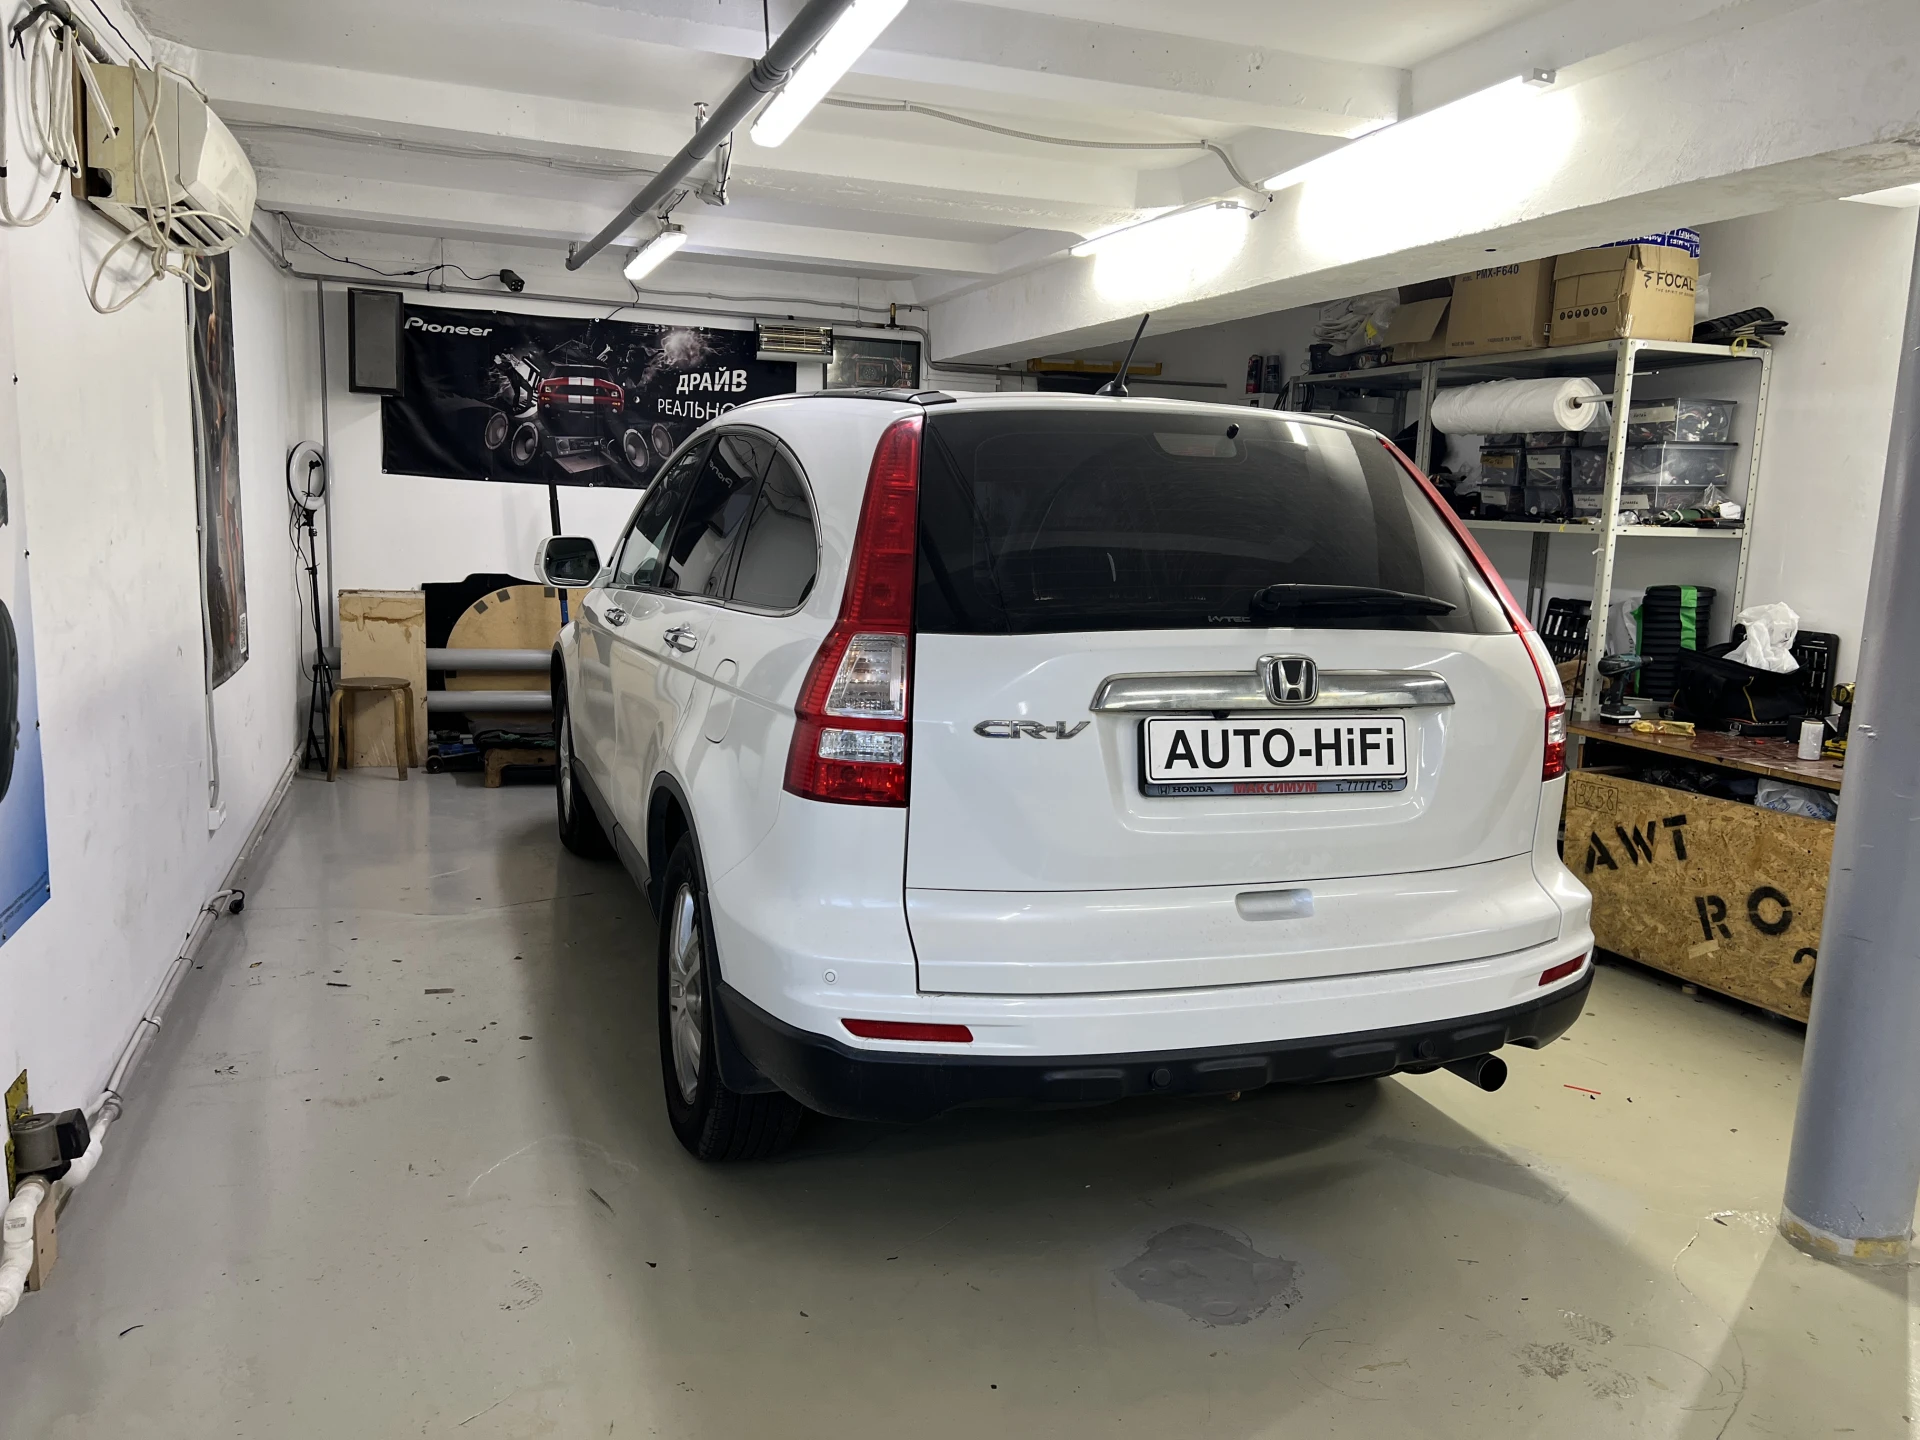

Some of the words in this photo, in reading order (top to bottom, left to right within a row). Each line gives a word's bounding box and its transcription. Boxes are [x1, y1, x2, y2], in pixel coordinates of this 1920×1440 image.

[1476, 264, 1519, 280] PMX-F640
[1656, 272, 1694, 291] FOCAL
[404, 317, 493, 338] Pioneer
[676, 366, 748, 395] ДРАЙВ
[973, 720, 1091, 740] CR-V
[1164, 727, 1396, 770] AUTO-HiFi
[1172, 785, 1214, 794] HONDA
[1233, 782, 1317, 794] МАКСИМУМ
[1347, 780, 1393, 792] 77777-65
[1577, 783, 1614, 811] 3258
[1585, 814, 1687, 874] AWT
